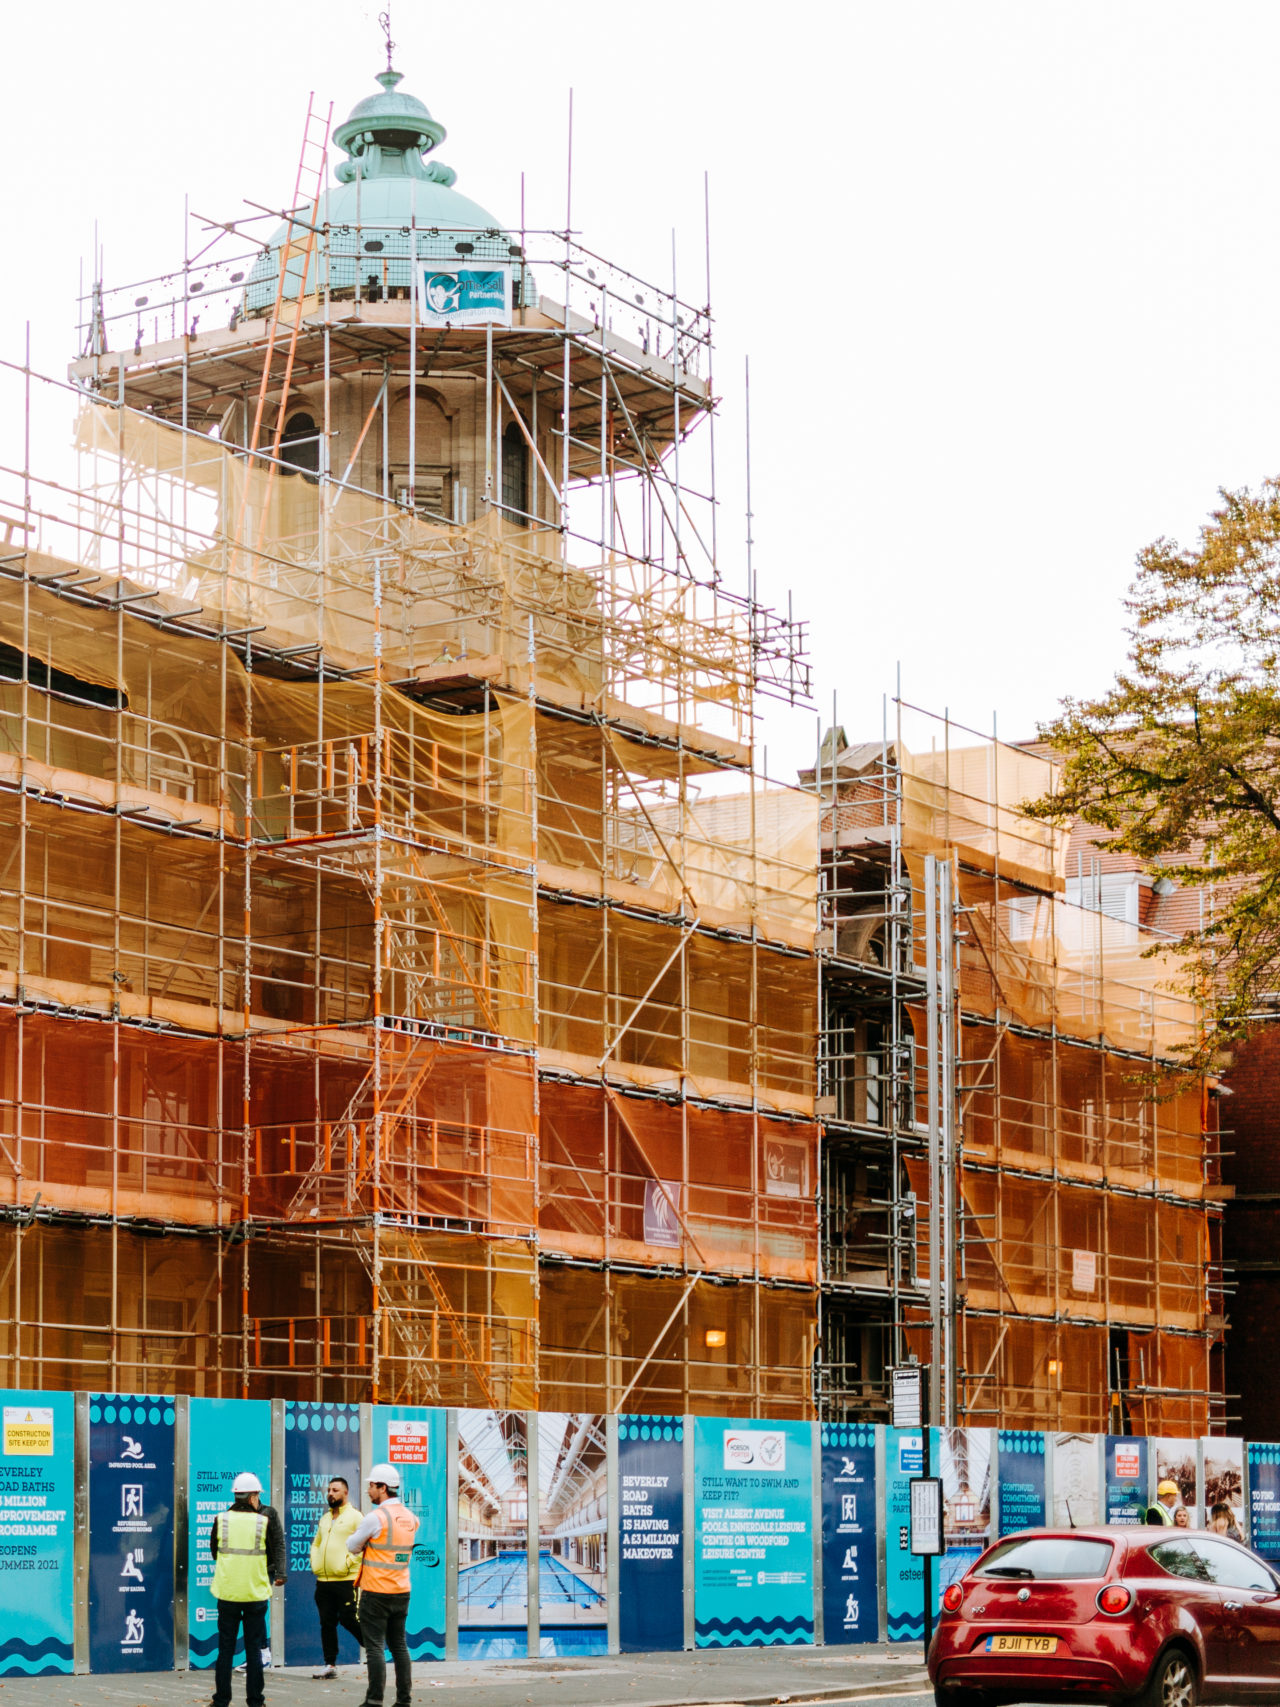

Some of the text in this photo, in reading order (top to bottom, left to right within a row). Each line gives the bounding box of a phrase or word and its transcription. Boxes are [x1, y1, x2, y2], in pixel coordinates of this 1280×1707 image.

[469, 291, 505, 301] Partnership
[196, 1472, 218, 1480] STILL
[291, 1474, 310, 1487] WE
[623, 1476, 669, 1487] BEVERLEY
[702, 1477, 799, 1488] STILL WANT TO SWIM AND
[22, 1482, 55, 1492] BATHS
[196, 1484, 223, 1492] SWIM?
[1003, 1483, 1035, 1491] CONTINUED
[291, 1491, 306, 1504] BE
[623, 1490, 648, 1501] ROAD
[702, 1490, 739, 1500] KEEP FIT?
[1003, 1494, 1040, 1502] COMMITMENT
[1252, 1491, 1274, 1500] TO FIND
[4, 1496, 47, 1506] MILLION
[196, 1502, 216, 1510] DIVE
[217, 1502, 227, 1510] IN
[623, 1505, 653, 1516] BATHS
[1011, 1505, 1040, 1513] INVESTING
[1253, 1502, 1264, 1511] OUT
[291, 1508, 324, 1520] WITH
[702, 1508, 784, 1519] VISIT ALBERT AVENUE
[623, 1519, 669, 1530] IS HAVING
[1010, 1516, 1028, 1524] LOCAL
[730, 1522, 774, 1532] ENNERDALE
[775, 1522, 806, 1532] LEISURE
[623, 1534, 679, 1544] A £3 MILLION
[702, 1535, 789, 1546] CENTRE OR WOODFORD
[623, 1548, 673, 1559] MAKEOVER
[702, 1548, 766, 1559] LEISURE CENTRE
[38, 1560, 59, 1570] 2021
[196, 1565, 208, 1574] OR
[291, 1558, 311, 1571] 202
[1025, 1638, 1050, 1650] TYB
